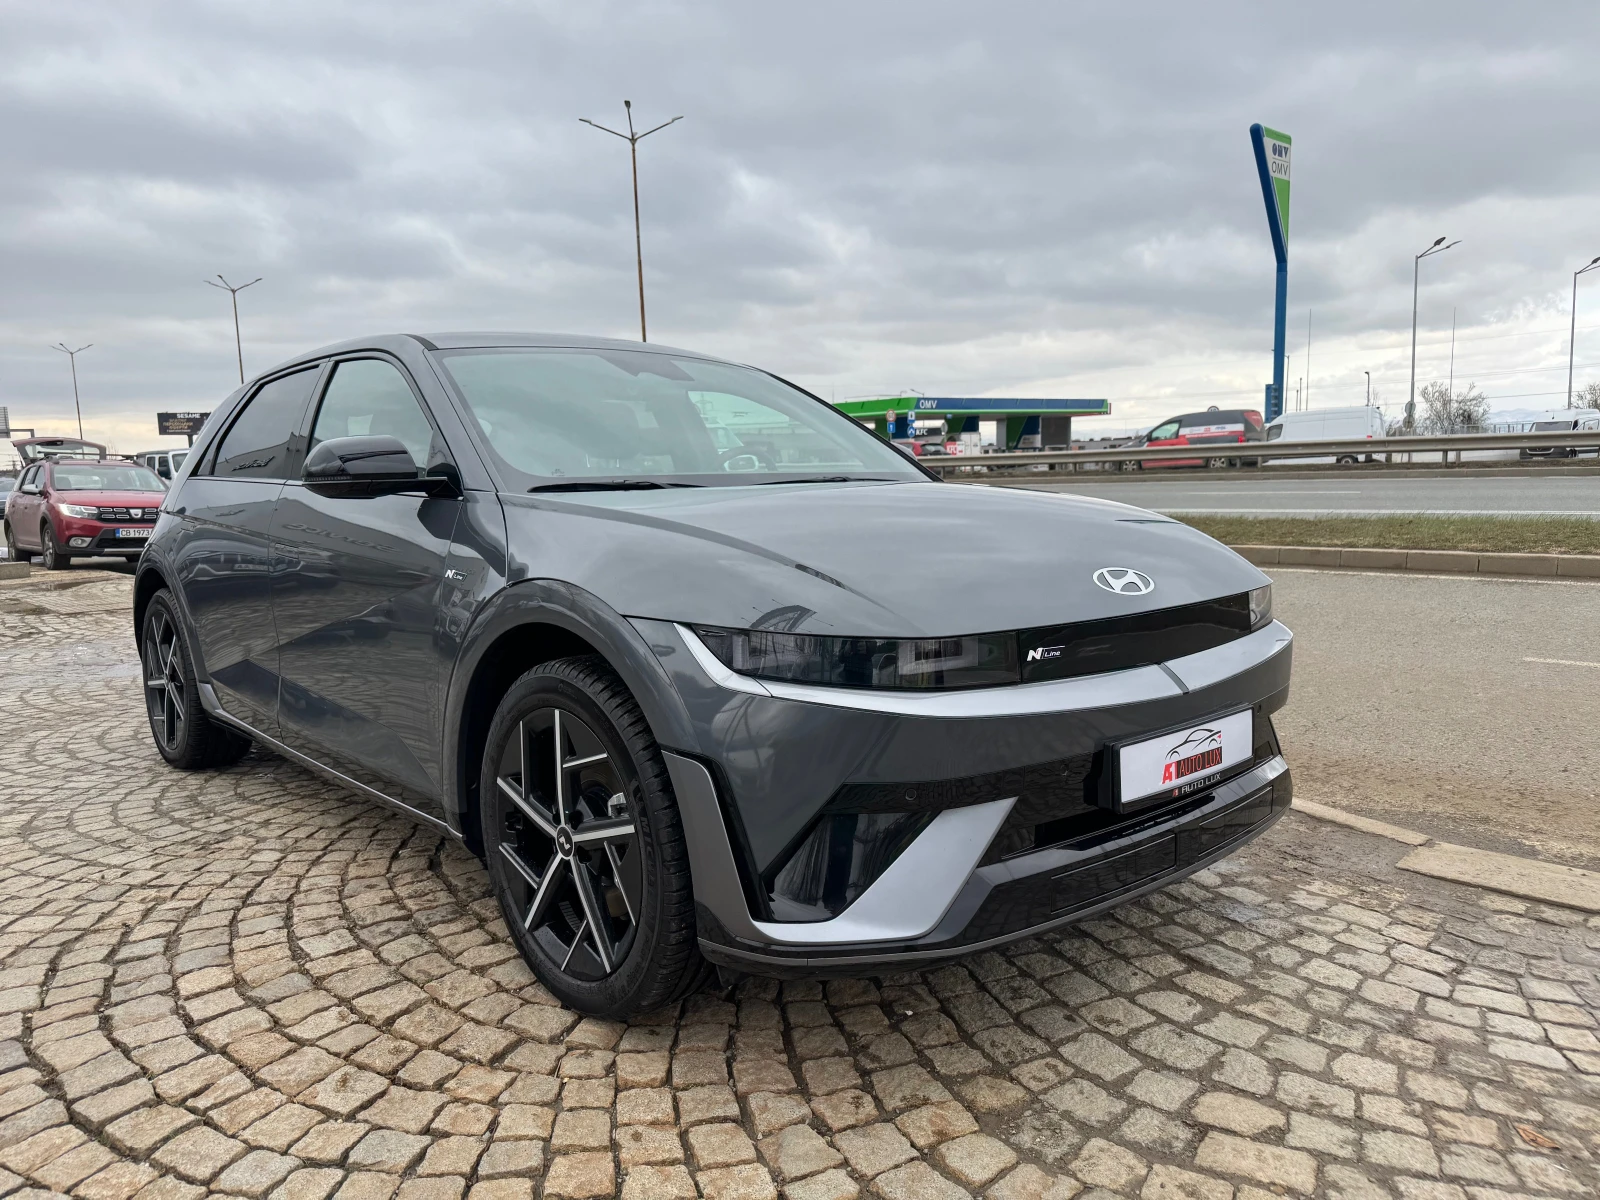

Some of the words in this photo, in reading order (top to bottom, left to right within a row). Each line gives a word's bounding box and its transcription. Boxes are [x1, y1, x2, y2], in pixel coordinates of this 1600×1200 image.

[1271, 161, 1288, 176] OMV
[919, 399, 937, 409] OMV
[916, 428, 928, 436] KFC
[133, 529, 150, 537] 1973
[1026, 647, 1043, 661] N
[1161, 760, 1178, 784] A1
[1179, 753, 1202, 776] AUTO
[1205, 747, 1221, 768] LUX
[1181, 780, 1203, 793] AUTO
[1205, 772, 1221, 783] LUX
